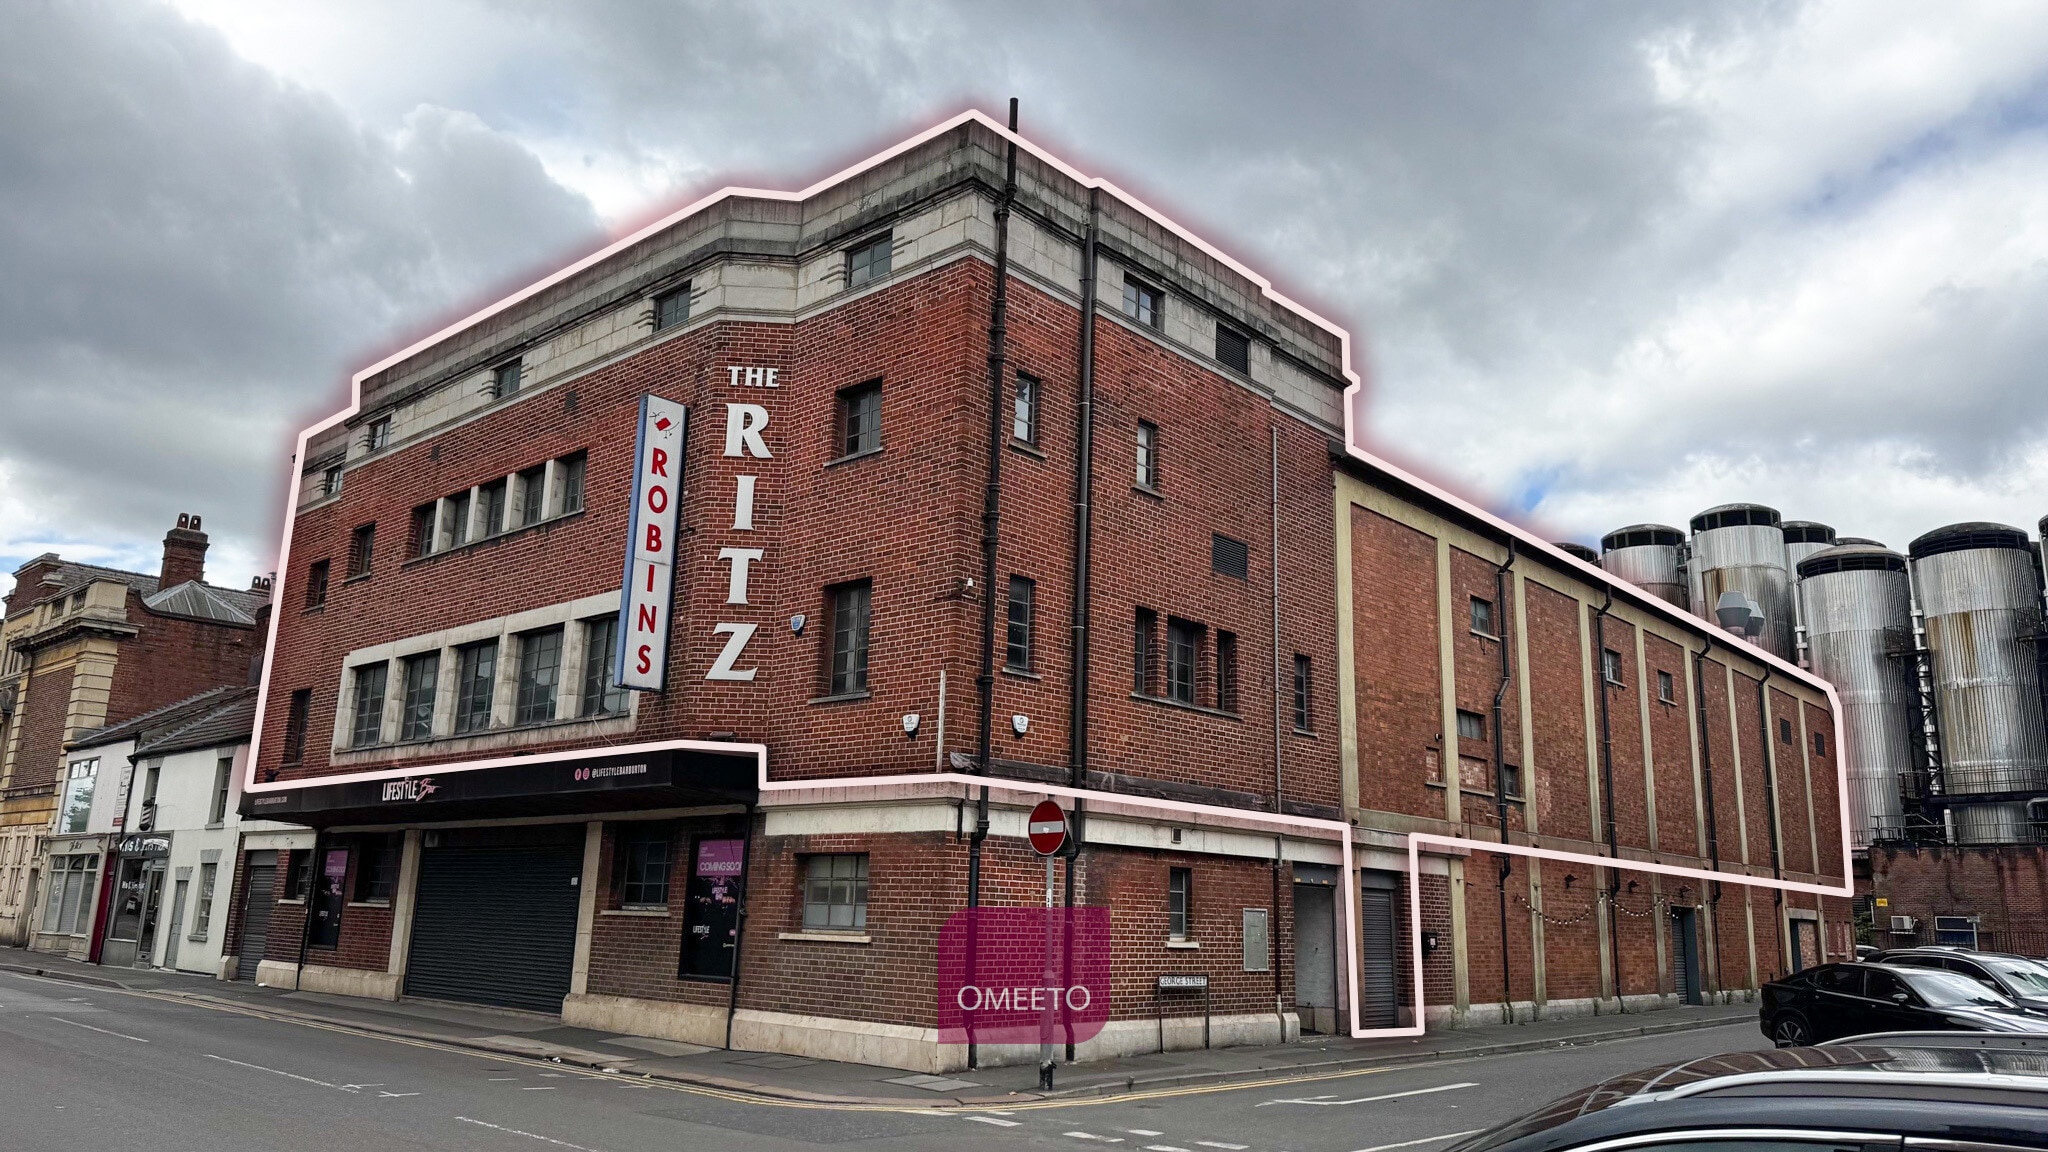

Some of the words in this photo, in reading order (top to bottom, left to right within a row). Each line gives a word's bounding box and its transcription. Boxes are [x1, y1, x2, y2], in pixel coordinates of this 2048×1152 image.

[727, 366, 779, 388] THE
[705, 403, 774, 681] RITZ
[636, 447, 668, 675] ROBINS
[382, 778, 418, 801] LIFESTYLE
[1160, 976, 1184, 985] GEORGE
[1185, 976, 1206, 985] STREET
